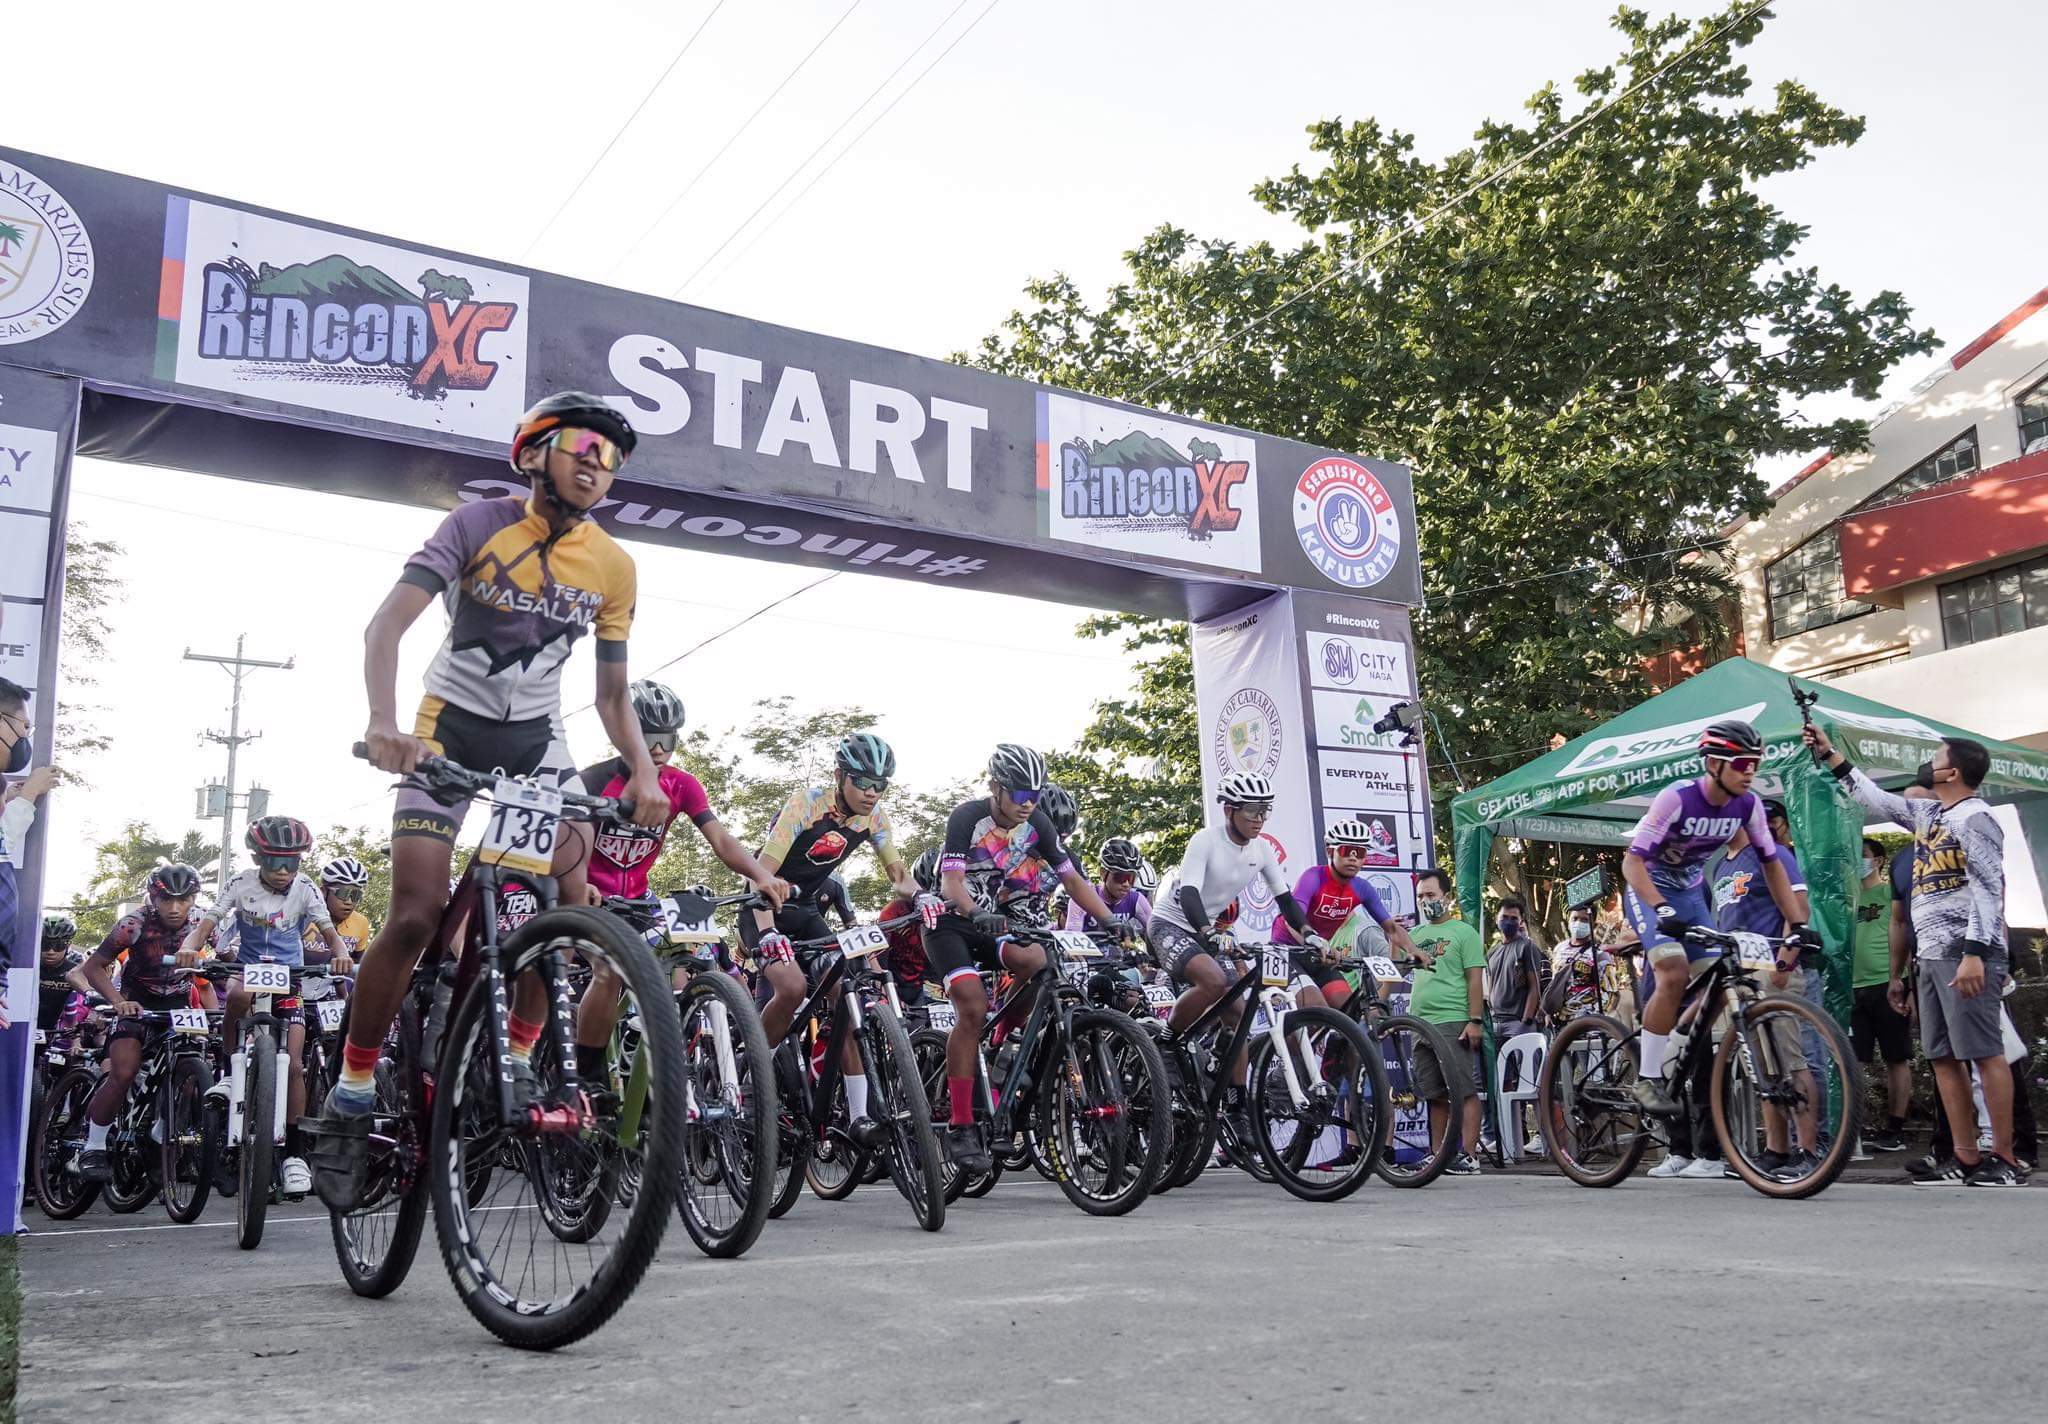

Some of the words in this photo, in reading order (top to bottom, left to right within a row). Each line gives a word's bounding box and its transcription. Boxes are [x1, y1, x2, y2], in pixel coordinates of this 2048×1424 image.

[37, 282, 84, 326] SUR
[602, 334, 988, 492] START
[0, 446, 32, 472] Y
[1305, 464, 1384, 506] SERBISYONG
[1301, 530, 1395, 583] KAFUERTE
[553, 583, 603, 606] TEAM
[1324, 642, 1354, 680] SM
[1360, 652, 1397, 671] CITY
[1369, 671, 1393, 681] NAGA
[1215, 715, 1231, 775] ROVINCE
[1225, 698, 1237, 716] OF
[1237, 690, 1280, 737] CAMARINES
[1266, 739, 1280, 767] SUR
[1340, 724, 1394, 748] Smart
[1620, 731, 1703, 758] Sma
[1860, 739, 1879, 757] GET
[1880, 742, 1900, 760] THE
[2012, 760, 2048, 781] PROMO
[1326, 768, 1389, 781] EVERYDAY
[1505, 791, 1530, 810] THE
[1557, 780, 1584, 800] APP
[1589, 774, 1618, 794] FOR
[1622, 768, 1650, 788] THE
[1652, 756, 1706, 782] LATEST
[493, 806, 556, 854] 136
[842, 930, 884, 952] 116
[1060, 936, 1097, 950] 142
[1264, 954, 1288, 977] 181
[1373, 962, 1397, 977] 63
[246, 970, 288, 988] 289
[1146, 990, 1174, 1002] 229
[174, 1013, 206, 1029] 211
